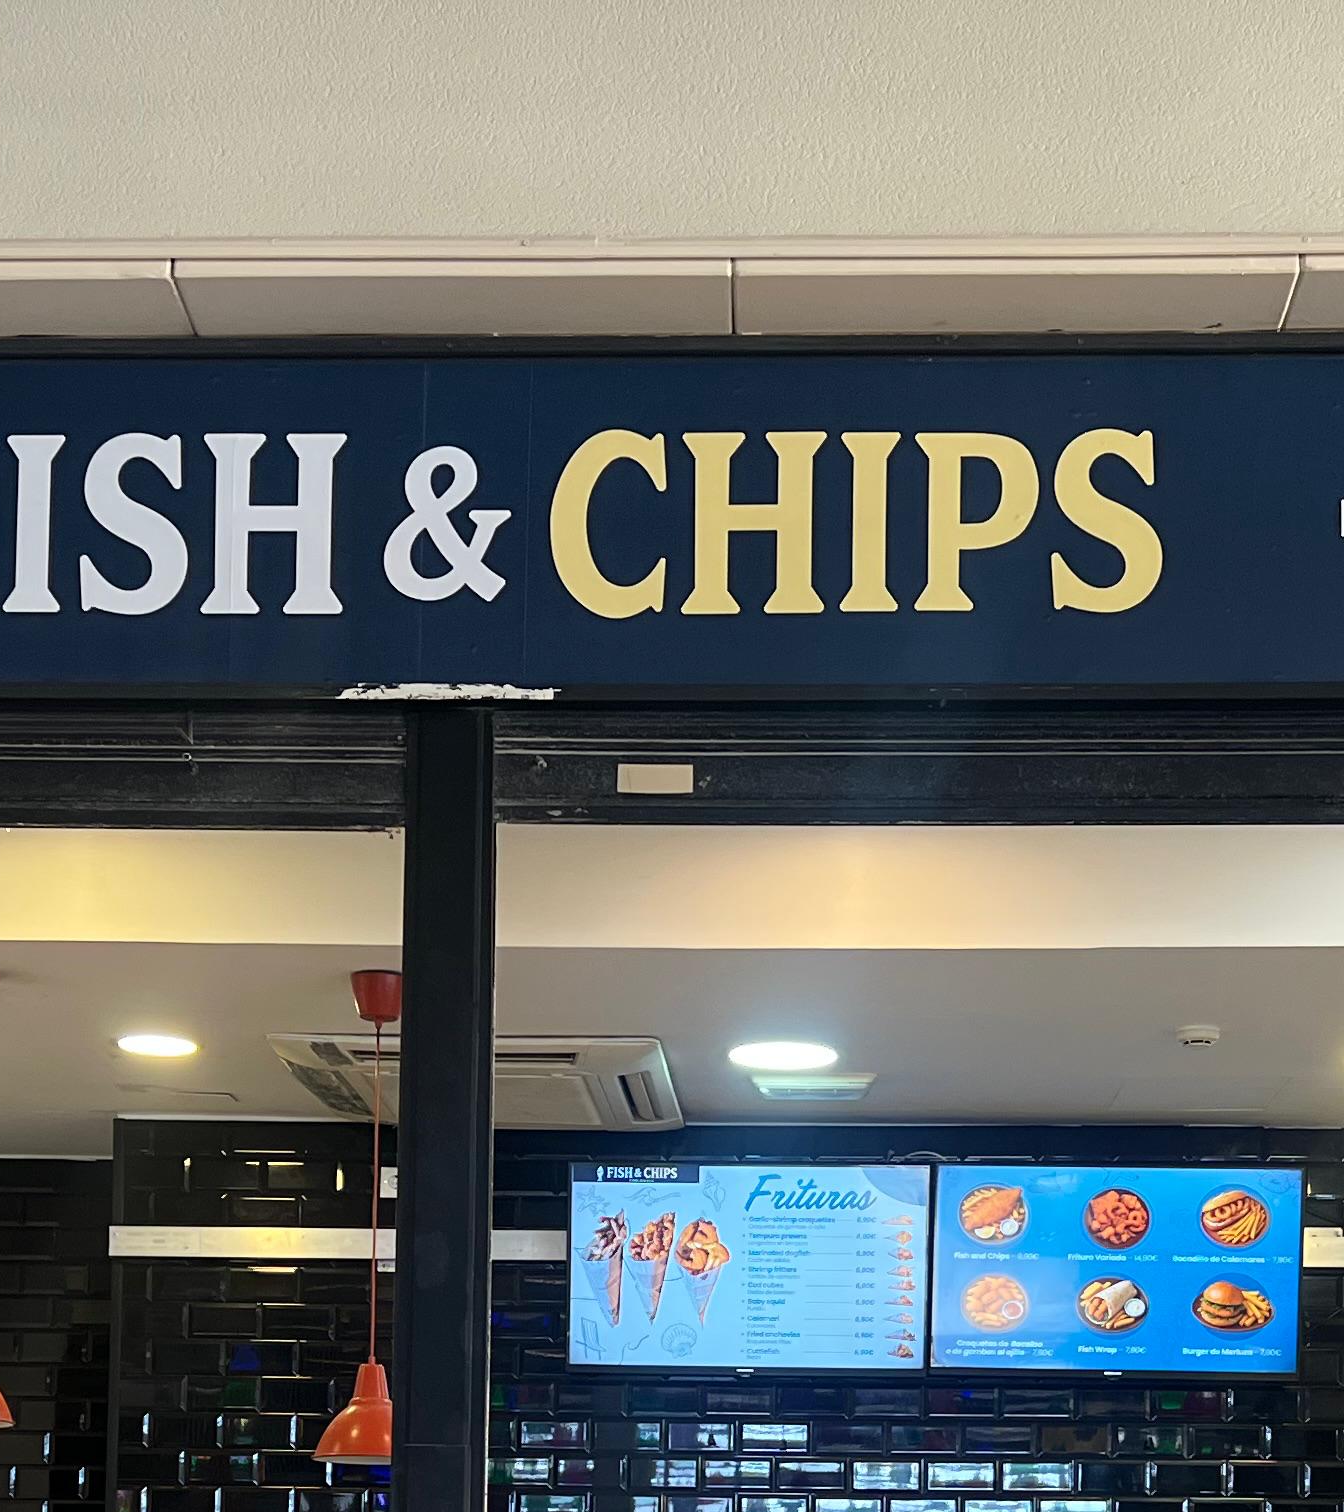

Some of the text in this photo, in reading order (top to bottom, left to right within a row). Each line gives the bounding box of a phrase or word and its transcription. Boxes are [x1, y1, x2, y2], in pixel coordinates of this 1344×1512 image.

[381, 444, 513, 604] &
[548, 428, 1164, 620] CHIPS
[606, 1166, 678, 1179] FISH & CHIPS
[744, 1174, 877, 1211] Frituras
[1078, 1345, 1094, 1353] Fish
